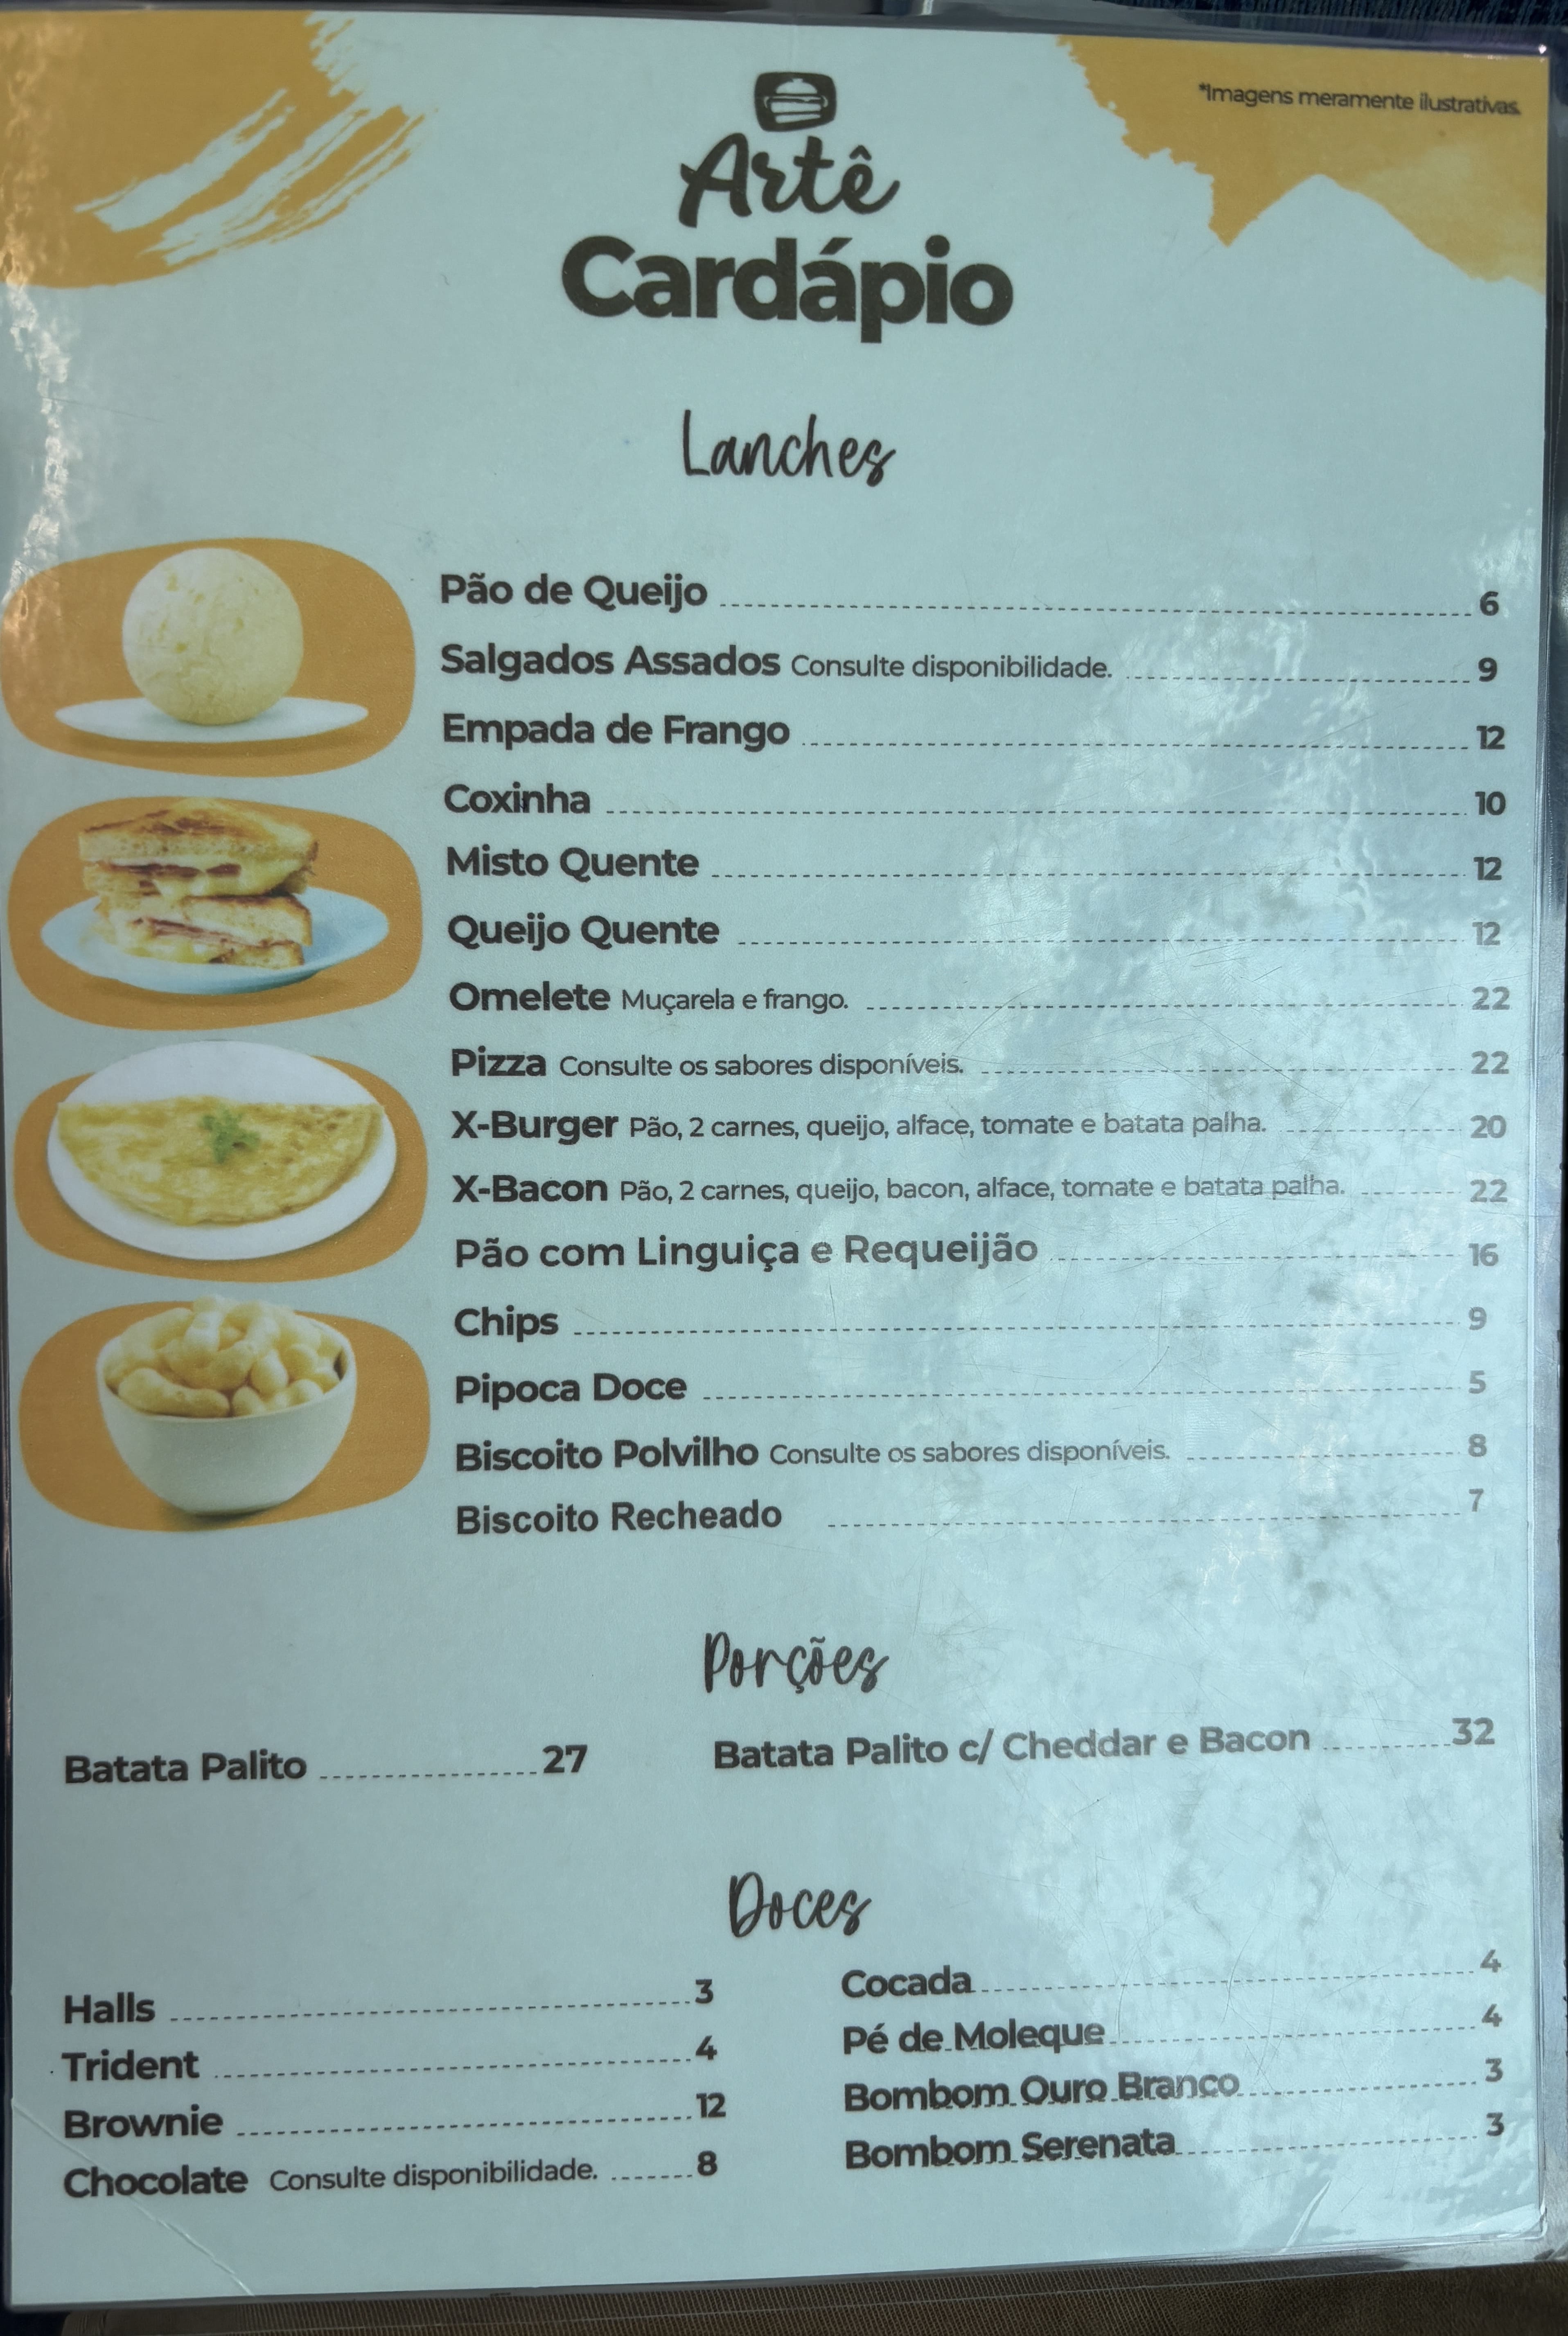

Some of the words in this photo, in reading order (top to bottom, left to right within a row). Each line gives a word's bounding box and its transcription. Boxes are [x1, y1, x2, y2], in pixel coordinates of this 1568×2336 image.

[1299, 91, 1414, 110] meramente
[1419, 92, 1521, 115] ilustrativas.
[679, 133, 900, 228] Artê
[562, 235, 1013, 343] Cardápio
[683, 409, 896, 487] Lanches
[441, 573, 512, 605] Pão
[524, 573, 573, 605] de
[584, 573, 707, 613] Queijo
[1480, 591, 1499, 616] 6
[441, 643, 614, 681] Salgados
[624, 645, 781, 676] Assados
[792, 654, 905, 676] Consulte
[912, 654, 1112, 682] disponibilidade.
[1478, 657, 1497, 682] 9
[444, 713, 594, 750] Empada
[606, 713, 652, 744] de
[664, 715, 790, 752] Frango
[1477, 725, 1505, 749] 12
[444, 781, 590, 814] Coxinha
[1475, 791, 1506, 815] 10
[447, 844, 548, 877] Misto
[560, 847, 699, 882] Quente
[1473, 857, 1502, 880] 12
[448, 912, 570, 951] Queijo
[581, 915, 720, 950] Quente
[1473, 921, 1500, 946] 12
[449, 981, 611, 1011] Omelete
[622, 988, 734, 1015] Muçarela
[742, 994, 757, 1009] e
[763, 988, 848, 1014] frango.
[1472, 986, 1510, 1010] 22
[452, 1046, 546, 1076] Pizza
[560, 1055, 672, 1076] Consulte
[680, 1060, 708, 1076] os
[715, 1054, 812, 1076] sabores
[819, 1053, 963, 1079] disponíveis.
[1471, 1051, 1509, 1074] 22
[451, 1111, 619, 1145] X-Burger
[630, 1116, 682, 1141] Pão,
[690, 1117, 704, 1137] 2
[711, 1121, 799, 1139] carnes,
[807, 1115, 889, 1141] queijo,
[897, 1114, 974, 1138] alface,
[981, 1116, 1073, 1134] tomate
[1081, 1118, 1096, 1134] e
[1104, 1112, 1184, 1133] batata
[1193, 1111, 1266, 1137] palha.
[1471, 1115, 1507, 1139] 20
[453, 1175, 608, 1202] X-Bacon
[621, 1180, 672, 1204] Pão,
[679, 1180, 694, 1200] 2
[701, 1184, 789, 1203] carnes,
[796, 1177, 879, 1204] queijo,
[887, 1178, 969, 1202] bacon,
[977, 1177, 1054, 1202] alface,
[1062, 1178, 1154, 1201] tomate
[1161, 1181, 1176, 1196] e
[1184, 1175, 1264, 1196] batata
[1271, 1174, 1345, 1200] palha.
[1470, 1179, 1507, 1203] 22
[456, 1238, 528, 1268] Pão
[540, 1244, 624, 1267] com
[638, 1234, 799, 1272] Linguiça
[811, 1242, 833, 1263] e
[845, 1232, 1038, 1269] Requeijão
[1469, 1243, 1499, 1267] 16
[454, 1305, 559, 1342] Chips
[1469, 1307, 1487, 1330] 9
[456, 1373, 580, 1410] Pipoca
[594, 1373, 687, 1401] Doce
[1469, 1370, 1486, 1394] 5
[456, 1439, 602, 1471] Biscoito
[615, 1435, 759, 1468] Polvilho
[770, 1442, 880, 1465] Consulte
[888, 1447, 916, 1463] os
[923, 1441, 1020, 1463] sabores
[1027, 1439, 1170, 1466] disponíveis.
[1468, 1434, 1487, 1457] 8
[457, 1504, 598, 1535] Biscoito
[612, 1499, 782, 1531] Recheado
[1469, 1488, 1484, 1512] 7
[704, 1632, 889, 1694] Porções
[65, 1756, 188, 1784] Batata
[202, 1749, 307, 1781] Palito
[543, 1745, 587, 1774] 27
[715, 1740, 833, 1769] Batata
[847, 1733, 948, 1765] Palito
[959, 1728, 994, 1765] c/
[1003, 1728, 1157, 1761] Cheddar
[1167, 1734, 1188, 1755] e
[1200, 1726, 1310, 1754] Bacon
[1452, 1717, 1495, 1745] 32
[729, 1872, 871, 1938] Doces
[842, 1965, 972, 1998] Cocada
[1480, 1949, 1501, 1973] 4
[65, 1992, 155, 2024] Halls
[695, 1979, 713, 2004] 3
[844, 2023, 889, 2054] Pé
[899, 2022, 943, 2052] de
[955, 2018, 1105, 2054] Moleque
[1482, 2004, 1503, 2027] 4
[61, 2049, 200, 2081] Trident
[696, 2036, 717, 2060] 4
[845, 2078, 1009, 2111] Bombom
[1020, 2075, 1107, 2106] Ouro
[1118, 2072, 1240, 2101] Branco
[1485, 2058, 1503, 2082] 3
[65, 2104, 223, 2138] Brownie
[696, 2092, 726, 2118] 12
[846, 2135, 1011, 2169] Bombom
[1022, 2129, 1175, 2162] Serenata
[1487, 2113, 1505, 2137] 3
[64, 2165, 248, 2198] Chocolate
[270, 2166, 386, 2191] Consulte
[393, 2158, 597, 2190] disponibilidade.
[697, 2151, 717, 2176] 8
